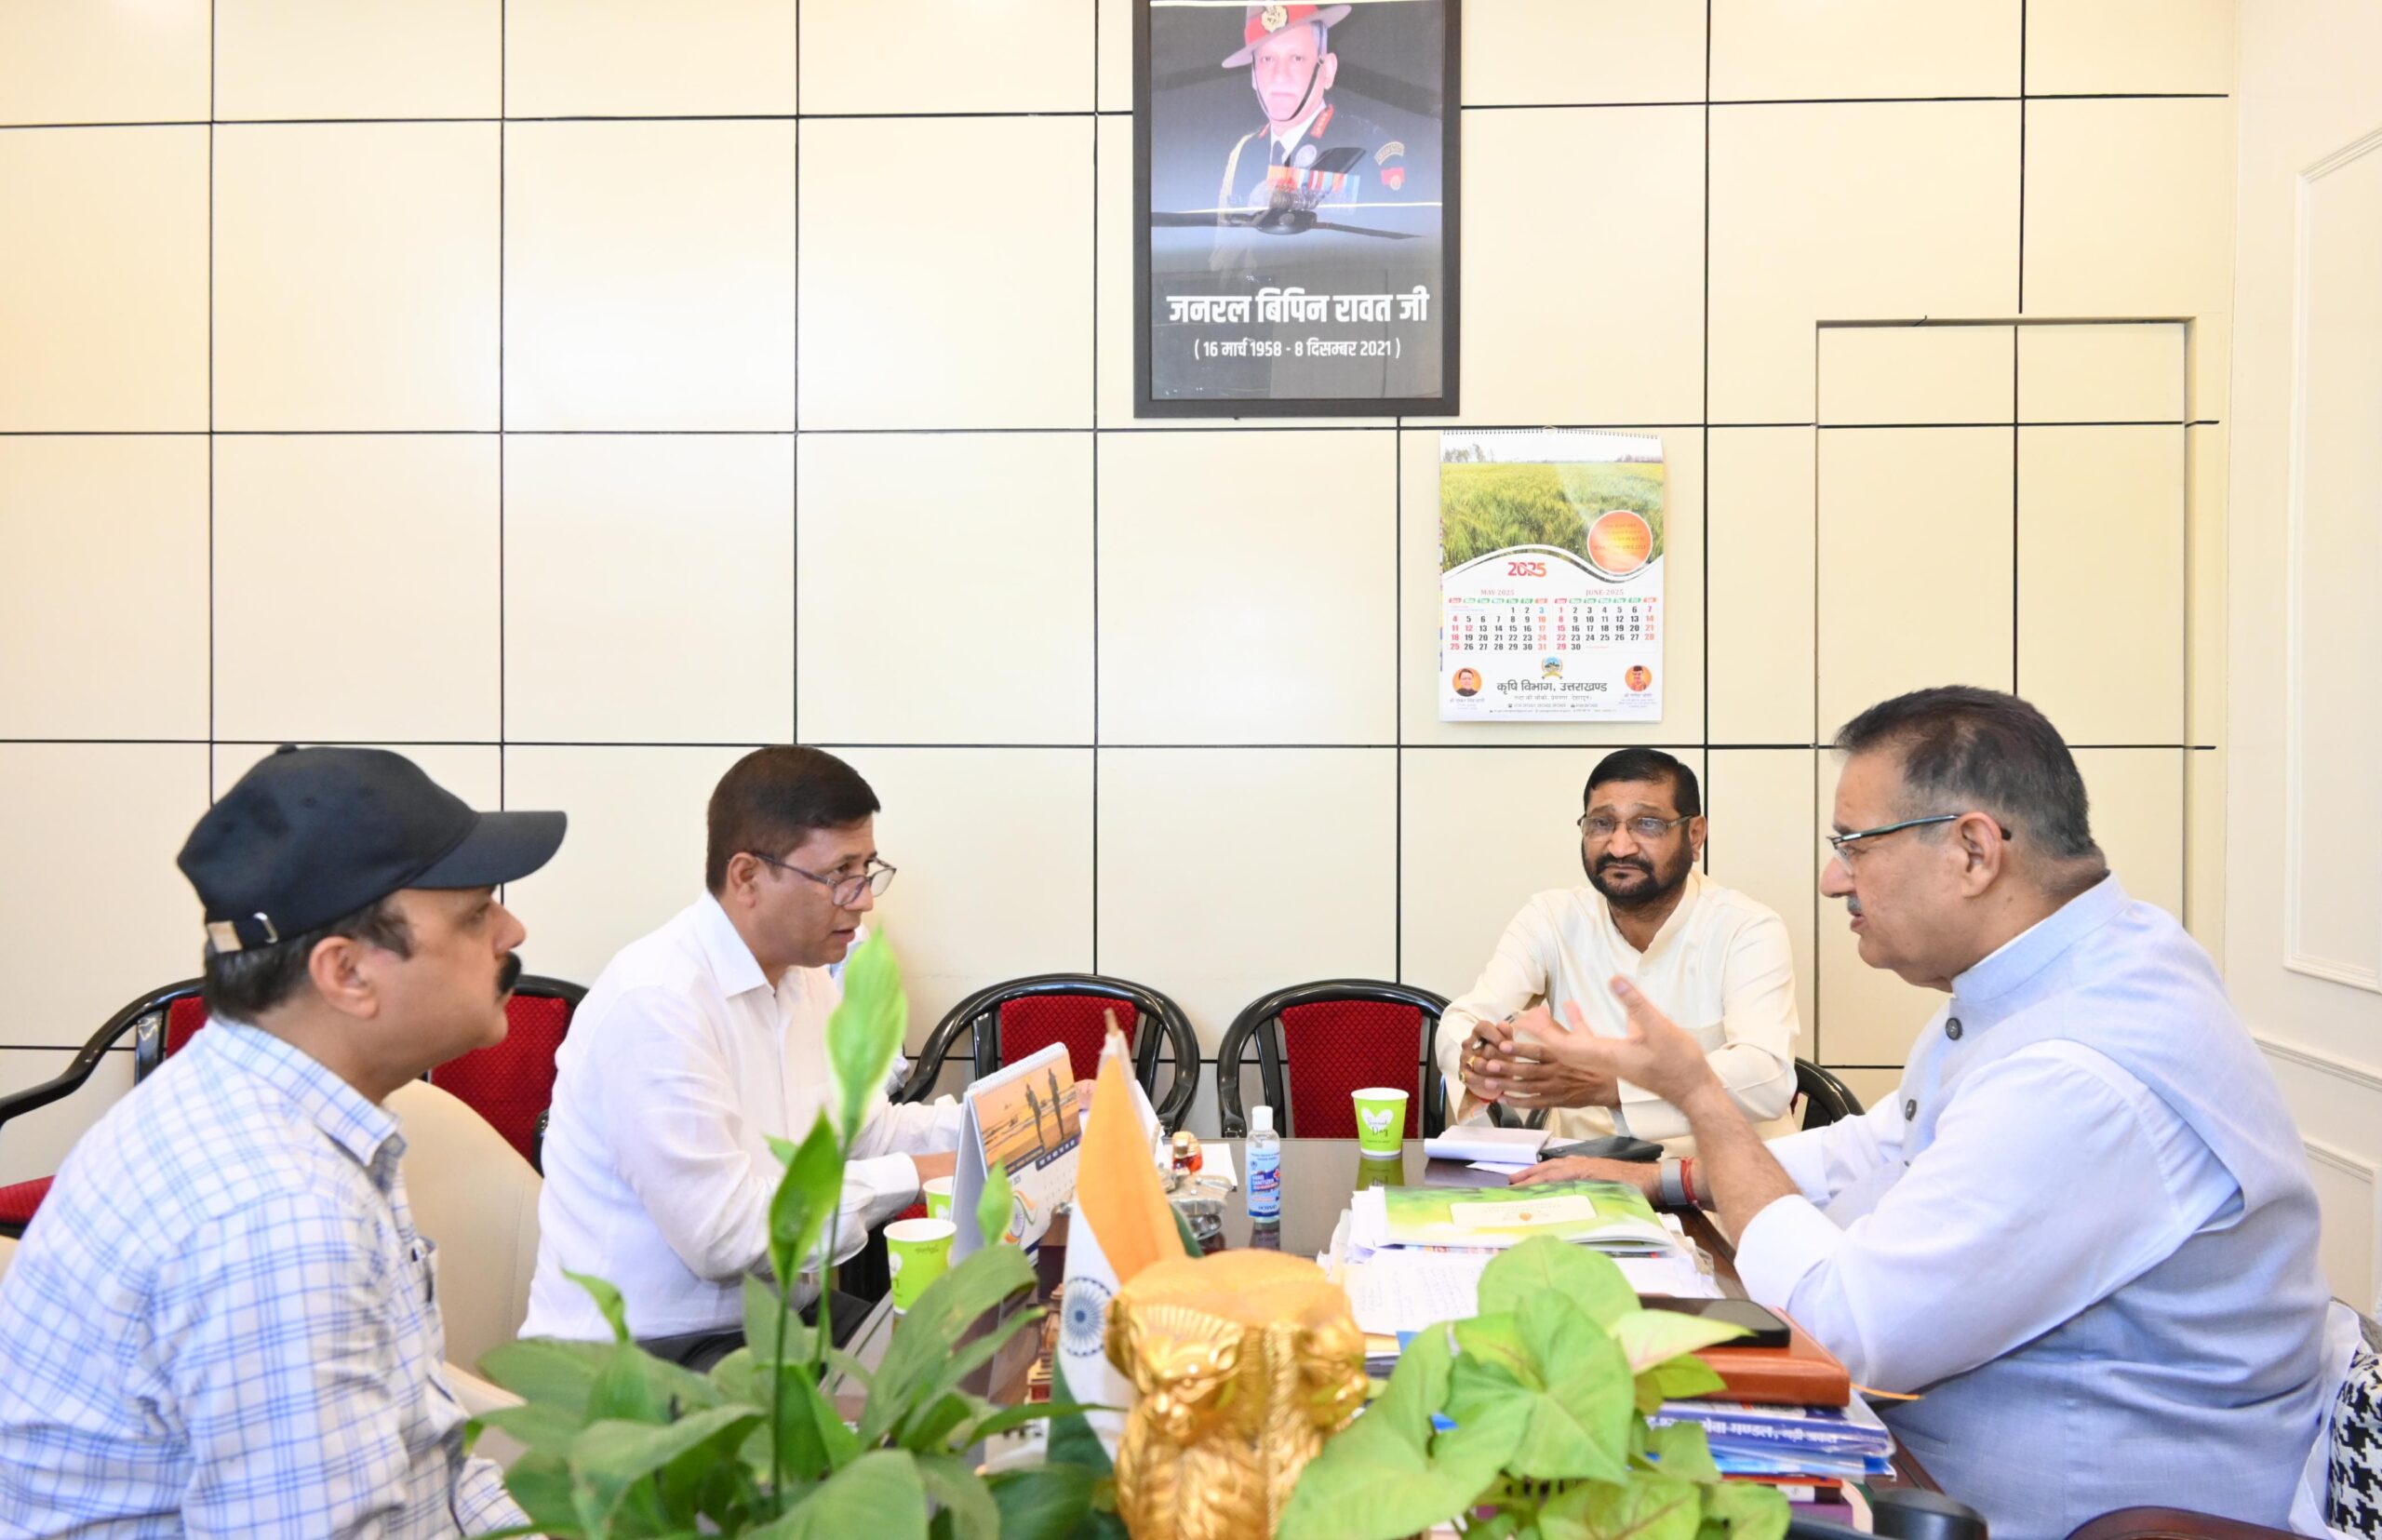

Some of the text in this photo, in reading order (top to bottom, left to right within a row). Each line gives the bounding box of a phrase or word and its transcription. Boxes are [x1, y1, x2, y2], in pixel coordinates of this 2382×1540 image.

[1166, 285, 1430, 323] जनरल बिपिन रावत जी
[1203, 341, 1219, 357] 16
[1221, 337, 1248, 357] मार्च
[1250, 340, 1282, 357] 1958
[1294, 341, 1304, 357] 8
[1306, 337, 1358, 357] दिसम्बर
[1359, 340, 1391, 356] 2021
[1507, 561, 1547, 578] 2025
[1537, 615, 1547, 624] 10
[1586, 615, 1595, 623] 10
[1600, 615, 1609, 623] 11
[1615, 615, 1625, 623] 12
[1645, 614, 1655, 623] 14
[1452, 623, 1460, 632] 11
[1465, 623, 1474, 633] 12
[1479, 624, 1488, 633] 13
[1508, 624, 1518, 633] 15
[1523, 624, 1532, 633] 16
[1538, 624, 1546, 633] 17
[1557, 623, 1654, 633] 15 16 17 18 19 20 21
[1451, 633, 1460, 641] 18
[1478, 634, 1489, 642] 20
[1494, 634, 1504, 642] 21
[1507, 634, 1519, 642] 22
[1522, 634, 1533, 642] 23
[1537, 634, 1547, 642] 24
[1556, 633, 1567, 642] 22
[1571, 634, 1581, 642] 23
[1586, 634, 1596, 642] 24
[1614, 633, 1626, 641] 26
[1629, 633, 1639, 641] 27
[1644, 632, 1655, 641] 28
[1450, 642, 1547, 651] 25 26 27 28 29 30 31
[1556, 642, 1567, 650] 29
[1571, 643, 1582, 651] 30
[1496, 678, 1519, 695] कृषि
[1559, 681, 1608, 692] उत्तराखण्ड
[1372, 1125, 1388, 1137] Day
